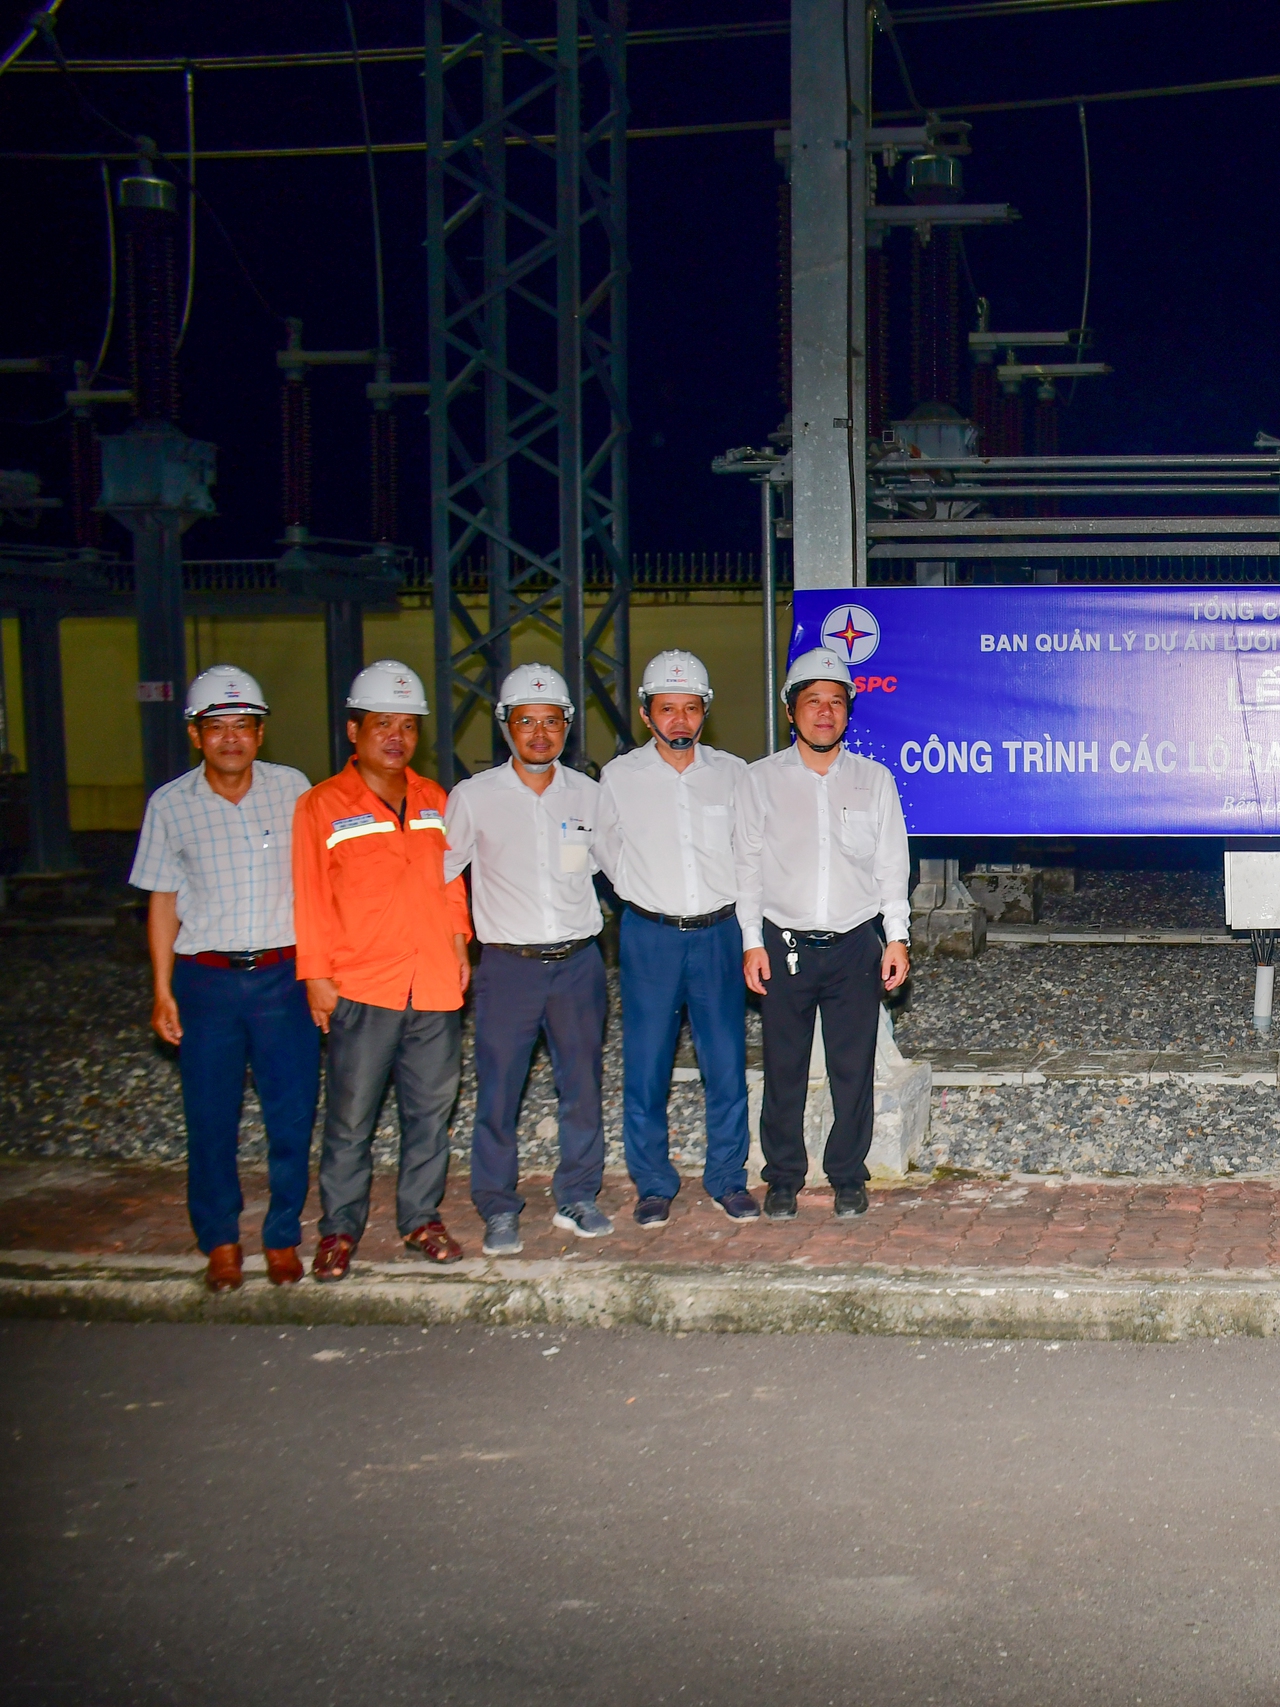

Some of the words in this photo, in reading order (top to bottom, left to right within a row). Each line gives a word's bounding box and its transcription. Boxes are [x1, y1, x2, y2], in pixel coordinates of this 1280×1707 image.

[1190, 595, 1255, 621] TỔNG
[980, 633, 1028, 652] BAN
[1035, 628, 1101, 653] QUẢN
[1109, 630, 1137, 652] LÝ
[1144, 630, 1178, 655] DỰ
[1183, 630, 1216, 652] ÁN
[1224, 629, 1278, 652] LƯỚI
[900, 733, 993, 774] CÔNG
[1002, 733, 1099, 773] TRÌNH
[1109, 733, 1178, 774] CÁC
[1188, 733, 1232, 780] LỘ
[1220, 791, 1261, 813] Bến
